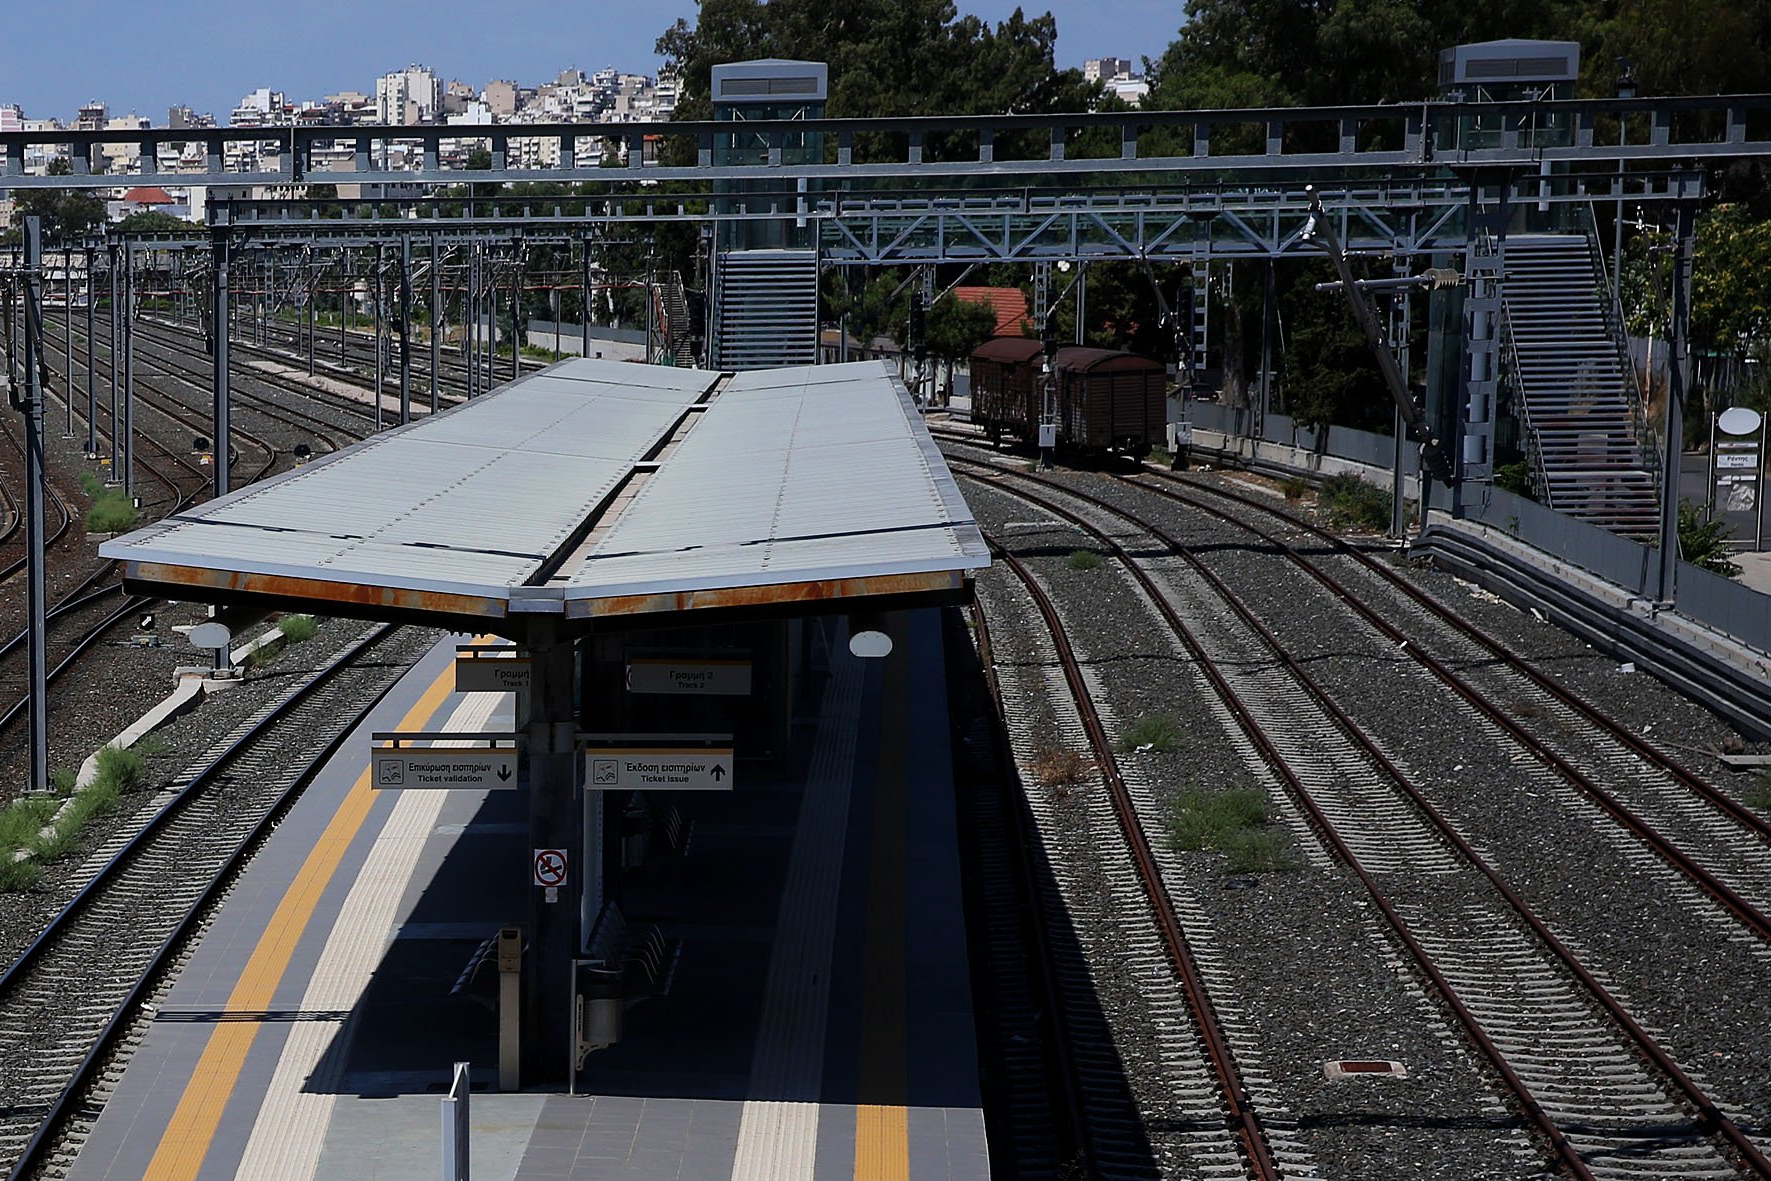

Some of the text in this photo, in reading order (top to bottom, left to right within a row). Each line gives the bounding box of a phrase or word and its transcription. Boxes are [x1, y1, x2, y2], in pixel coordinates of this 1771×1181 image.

[494, 669, 530, 679] Γραμμή
[669, 670, 714, 680] Γραμμή 2
[408, 762, 492, 774] Επικύρωση εισιτηρίων
[625, 762, 706, 774] Έκδοση εισιτηρίων
[641, 775, 689, 783] Ticket issue
